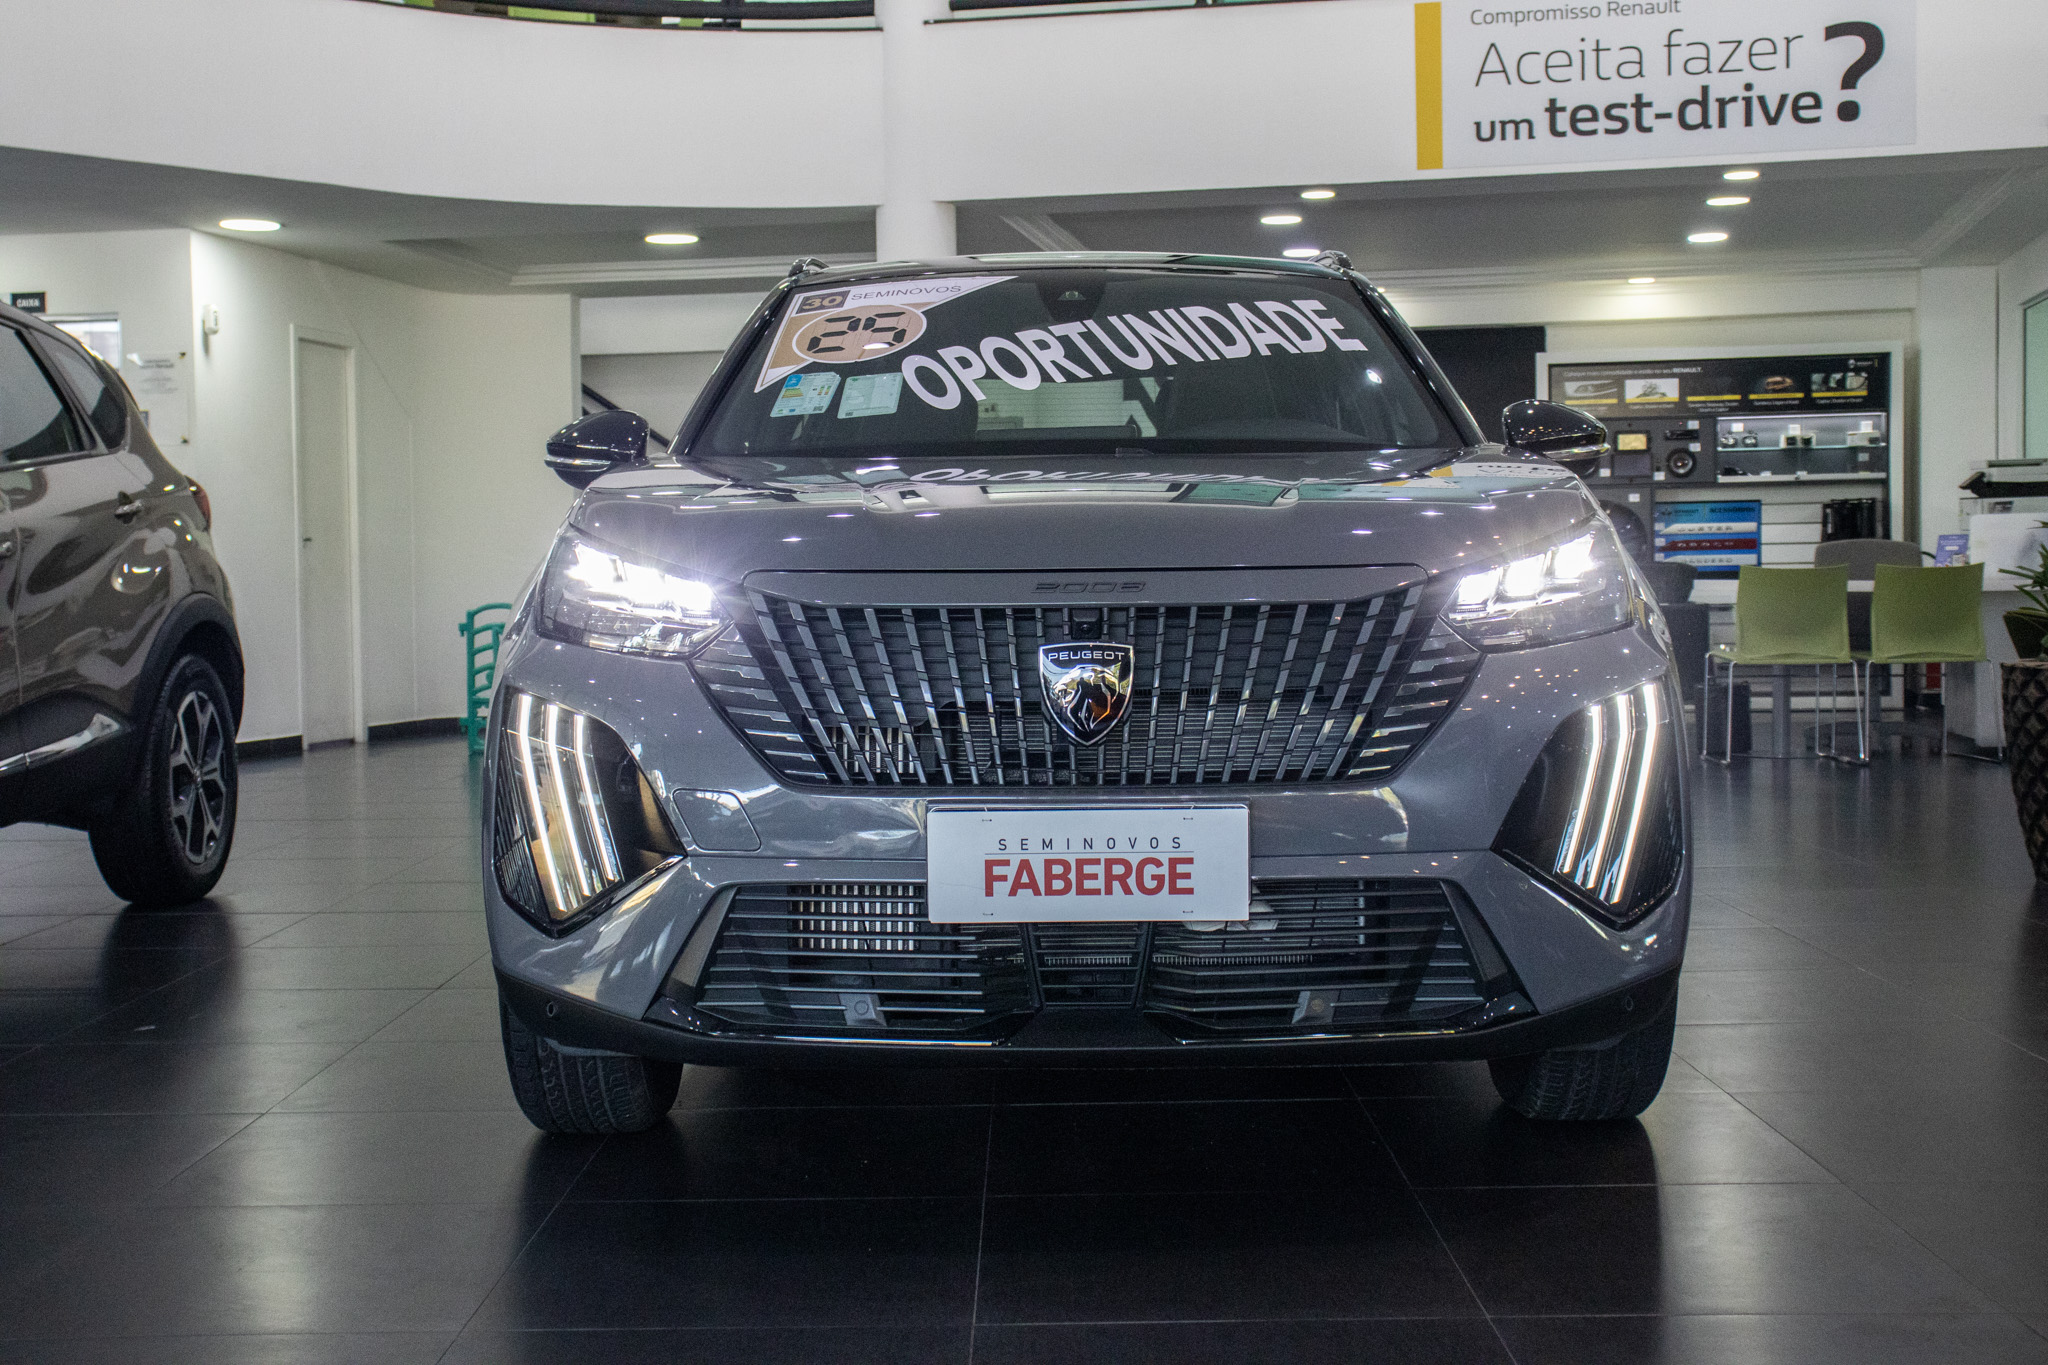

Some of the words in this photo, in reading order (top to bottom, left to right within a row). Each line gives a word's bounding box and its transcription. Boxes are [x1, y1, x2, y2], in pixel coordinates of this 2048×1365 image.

[1470, 4, 1602, 27] Compromisso
[1607, 0, 1681, 17] Renault
[1475, 37, 1646, 87] Aceita
[1663, 28, 1804, 77] fazer
[1473, 115, 1536, 142] um
[16, 298, 41, 308] CAIXA
[801, 295, 844, 311] 30
[850, 285, 963, 301] SEMINOVOS
[901, 299, 1369, 411] OPORTUNIDADE
[1030, 582, 1147, 594] 2008
[1048, 650, 1126, 661] PEUGEOT
[998, 836, 1183, 851] SEMINOVOS
[984, 856, 1195, 897] FABERGE
